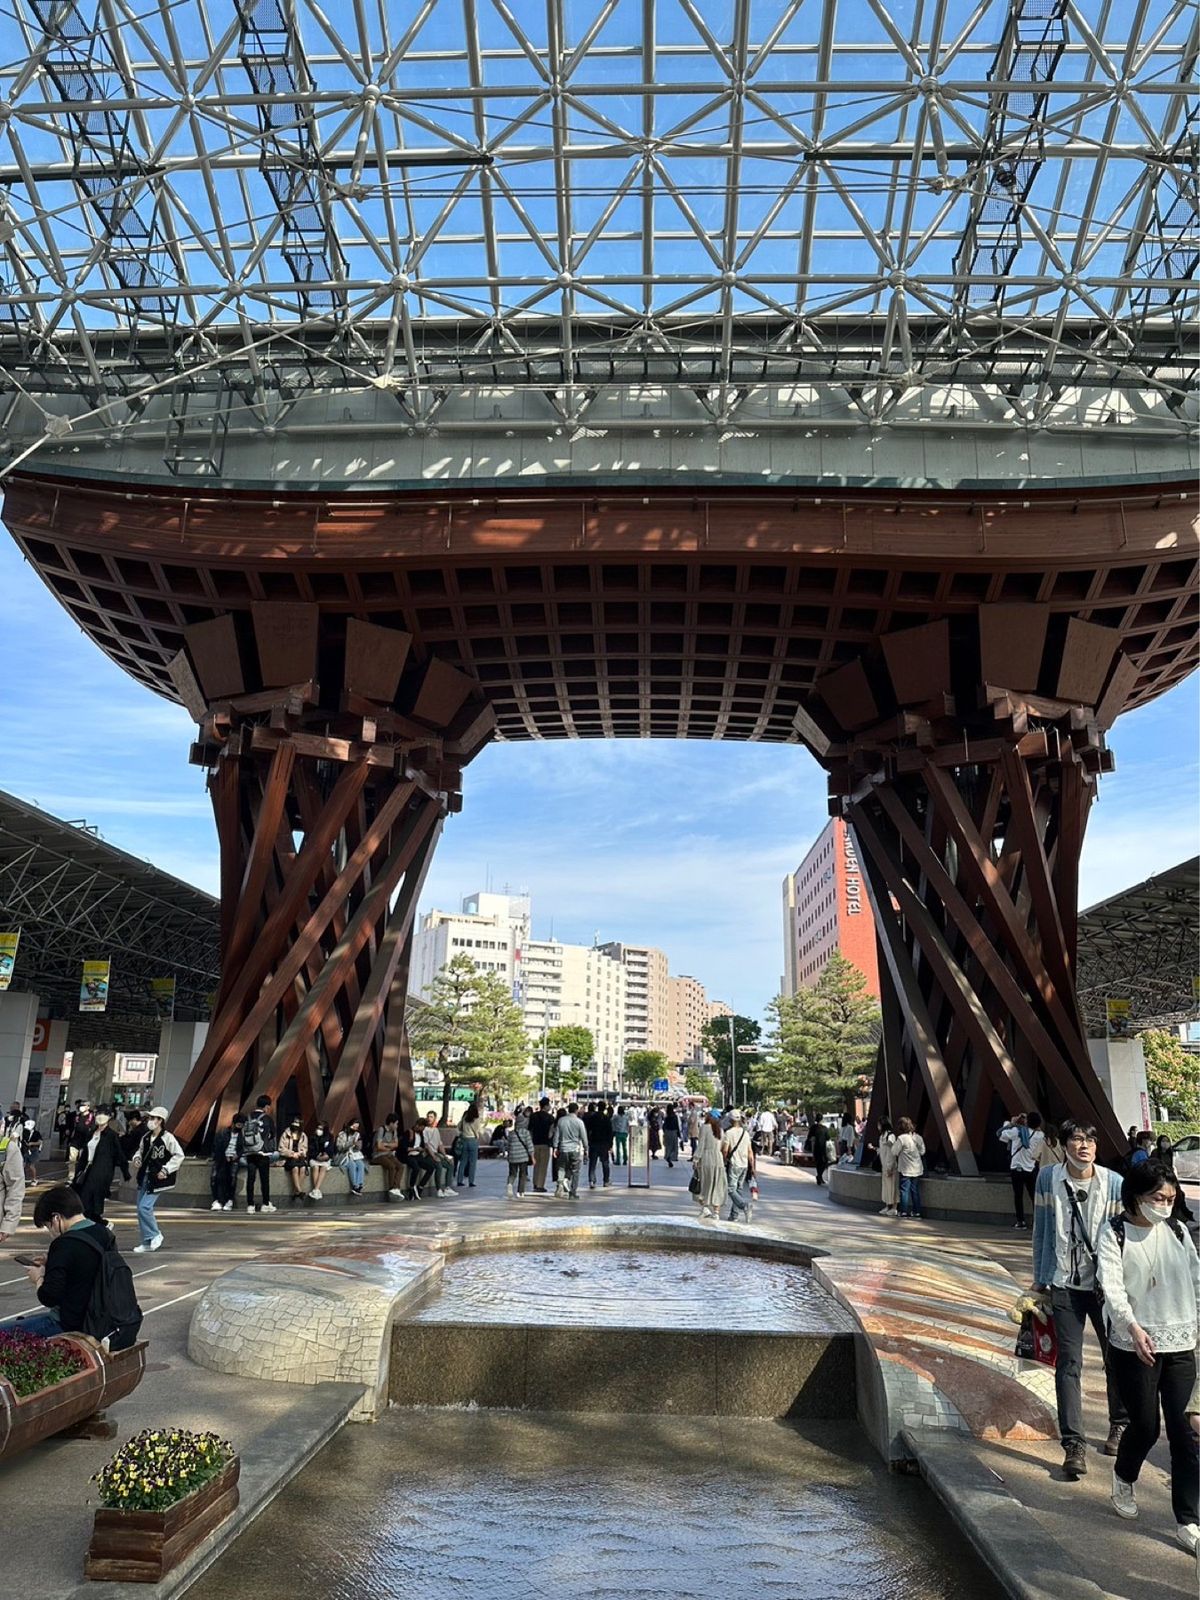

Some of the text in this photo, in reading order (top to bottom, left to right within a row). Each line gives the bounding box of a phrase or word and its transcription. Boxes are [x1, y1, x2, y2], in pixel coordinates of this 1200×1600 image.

[845, 877, 862, 917] HOTEL
[32, 1023, 46, 1046] 9
[151, 1145, 165, 1159] M
